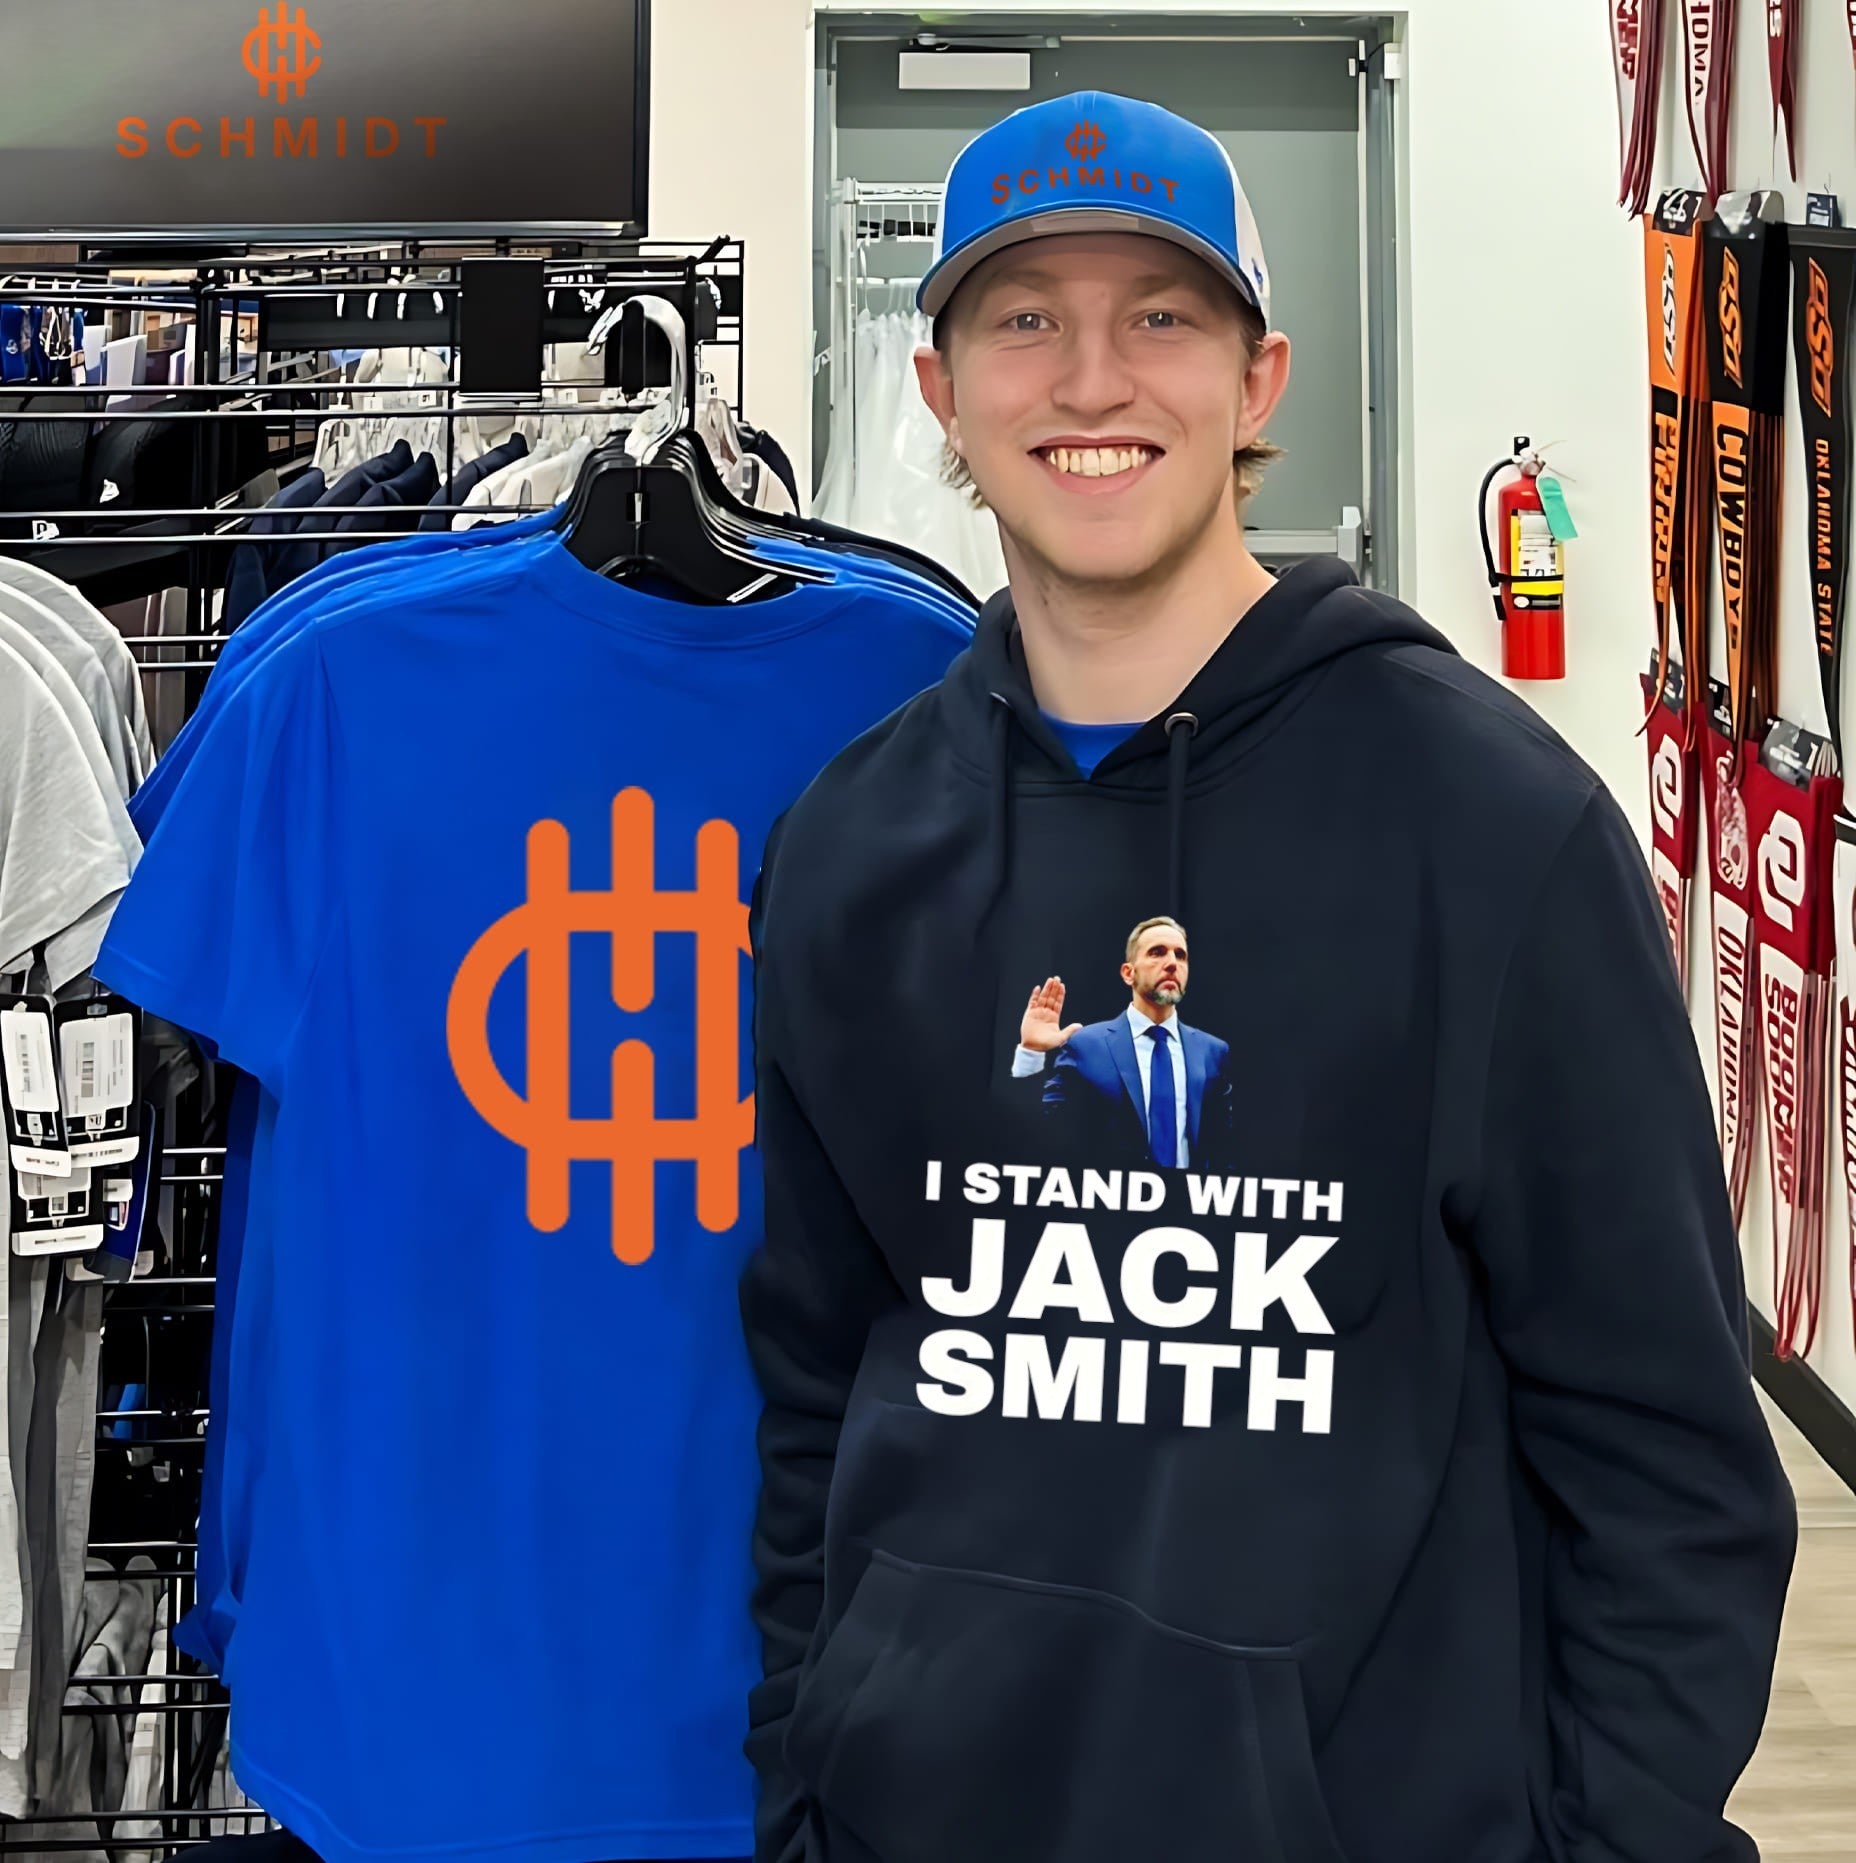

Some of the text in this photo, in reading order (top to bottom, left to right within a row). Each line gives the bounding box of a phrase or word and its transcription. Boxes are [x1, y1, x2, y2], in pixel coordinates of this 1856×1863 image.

[115, 116, 447, 158] SCHMIDT
[991, 167, 1179, 205] SCHMIDT
[1815, 438, 1833, 657] OKLAHOMA STATE
[1718, 926, 1745, 1144] OKLAHOMA
[926, 1160, 1344, 1222] I STAND WITH
[921, 1217, 1340, 1335] JACK
[916, 1328, 1335, 1434] SMITH
